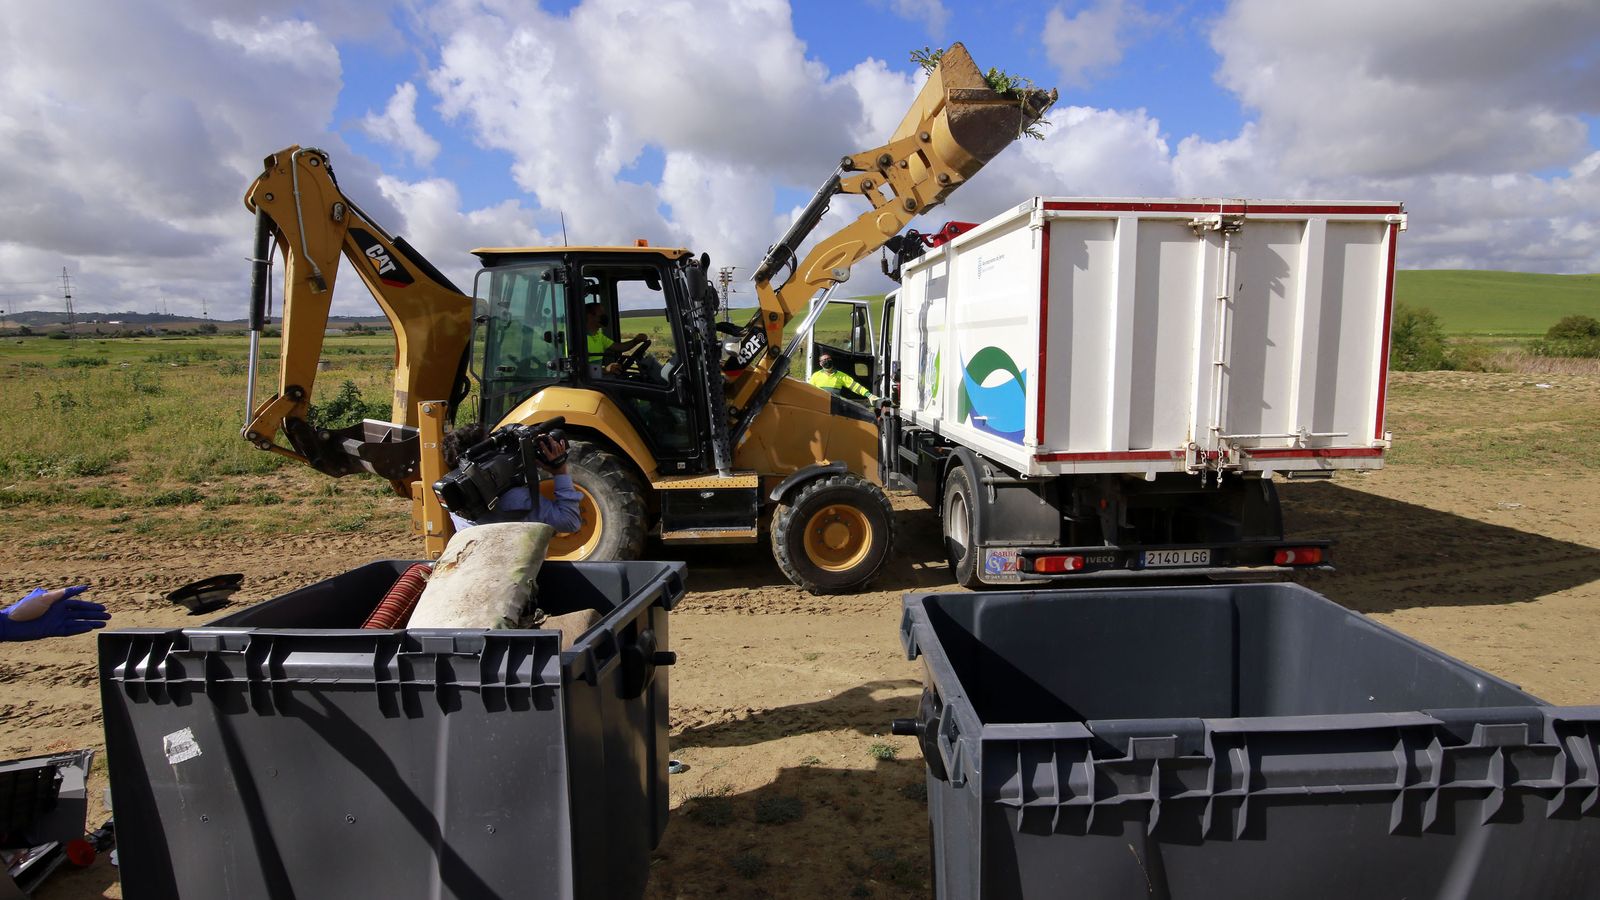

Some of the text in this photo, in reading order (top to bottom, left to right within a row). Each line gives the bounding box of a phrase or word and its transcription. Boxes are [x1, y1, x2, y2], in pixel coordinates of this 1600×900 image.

[365, 243, 397, 275] CAT
[1085, 555, 1115, 564] IVECO
[1147, 551, 1207, 565] 2140 LGG
